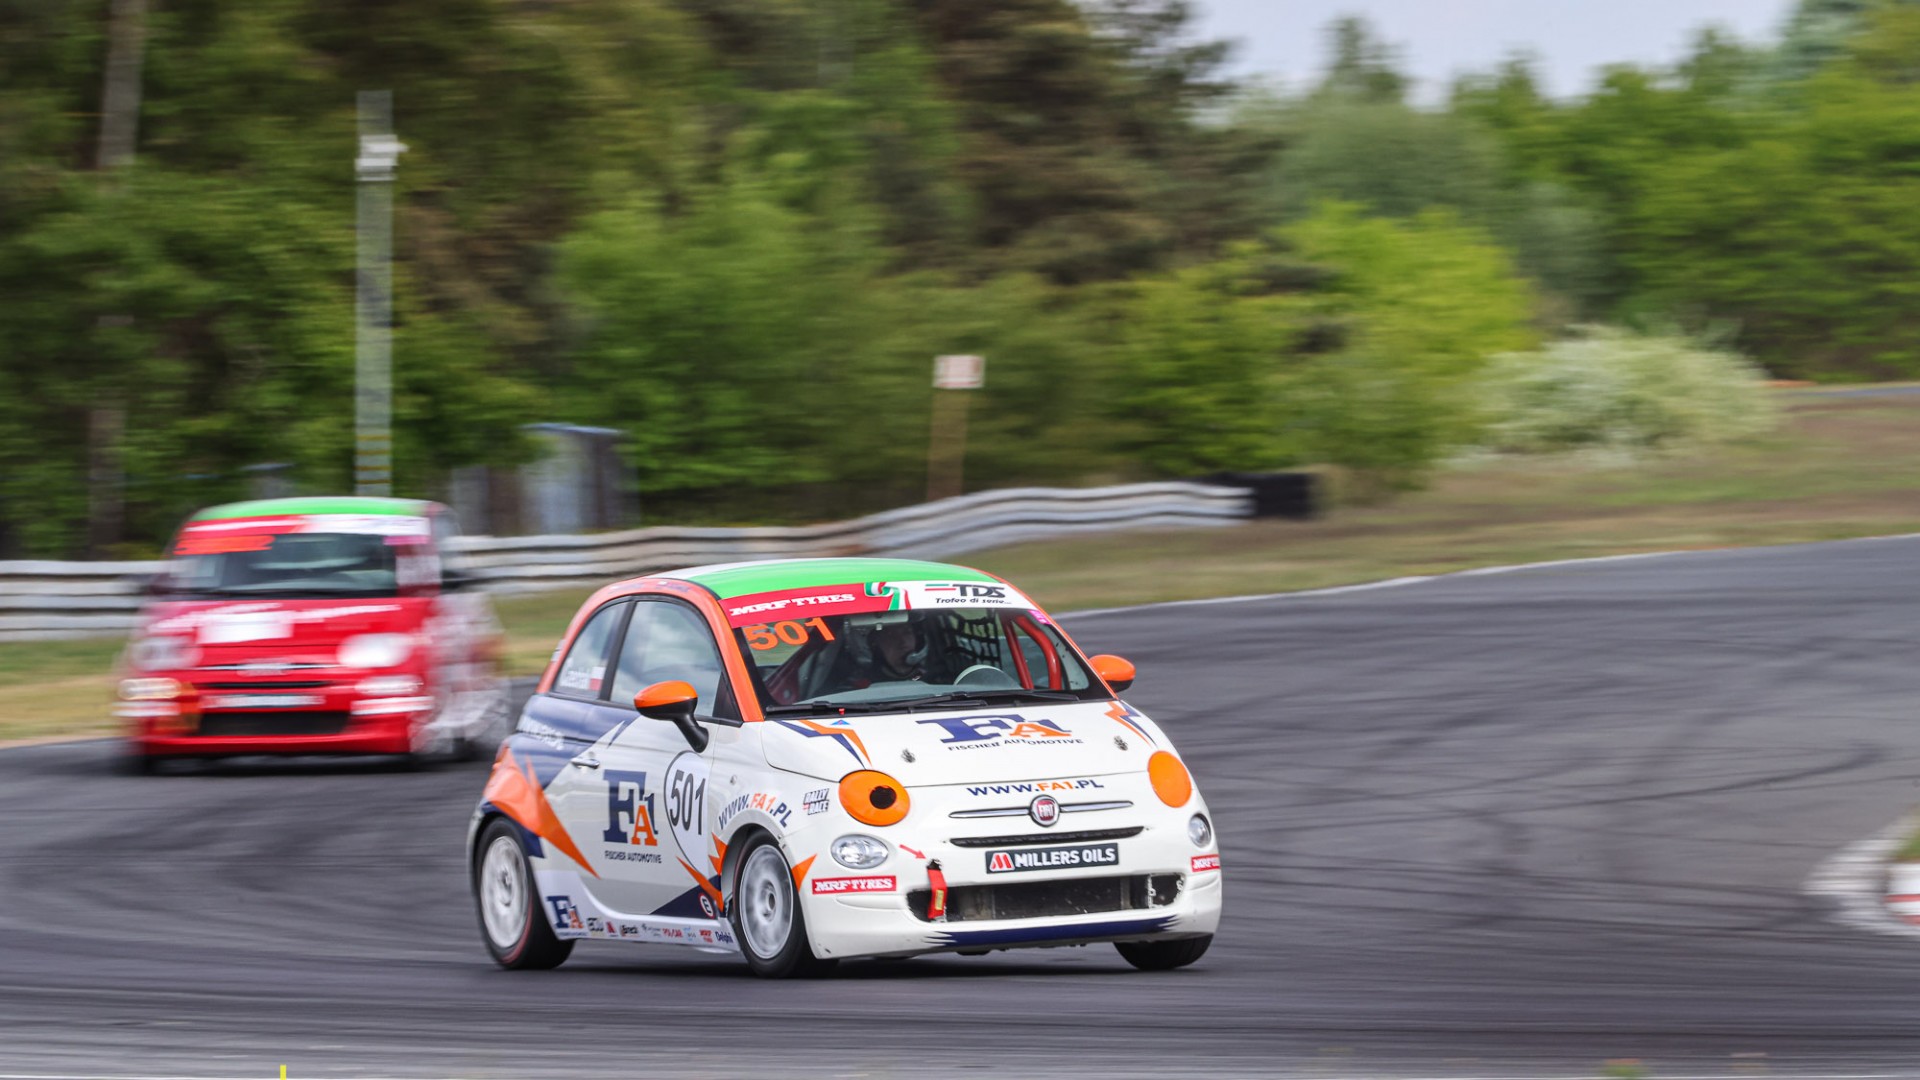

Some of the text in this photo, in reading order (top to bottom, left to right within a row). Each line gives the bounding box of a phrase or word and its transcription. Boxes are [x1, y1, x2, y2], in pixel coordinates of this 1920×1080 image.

[952, 584, 1005, 598] TDS
[729, 594, 856, 616] MRF TYRES
[742, 617, 835, 650] 501
[948, 738, 1084, 751] FISCHER AUTOMOTIVE
[967, 779, 1104, 796] WWW.FA1.PL
[669, 769, 706, 836] 501
[803, 788, 829, 804] RALLY
[718, 793, 792, 830] WWW.FA1.PL
[1037, 804, 1055, 818] FIAT
[604, 850, 662, 864] FISCHER AUTOMOTIVE
[1014, 850, 1079, 868] MILLERS
[1082, 848, 1116, 863] OILS
[815, 878, 893, 892] MRF TYRES
[715, 930, 734, 944] Delphi
